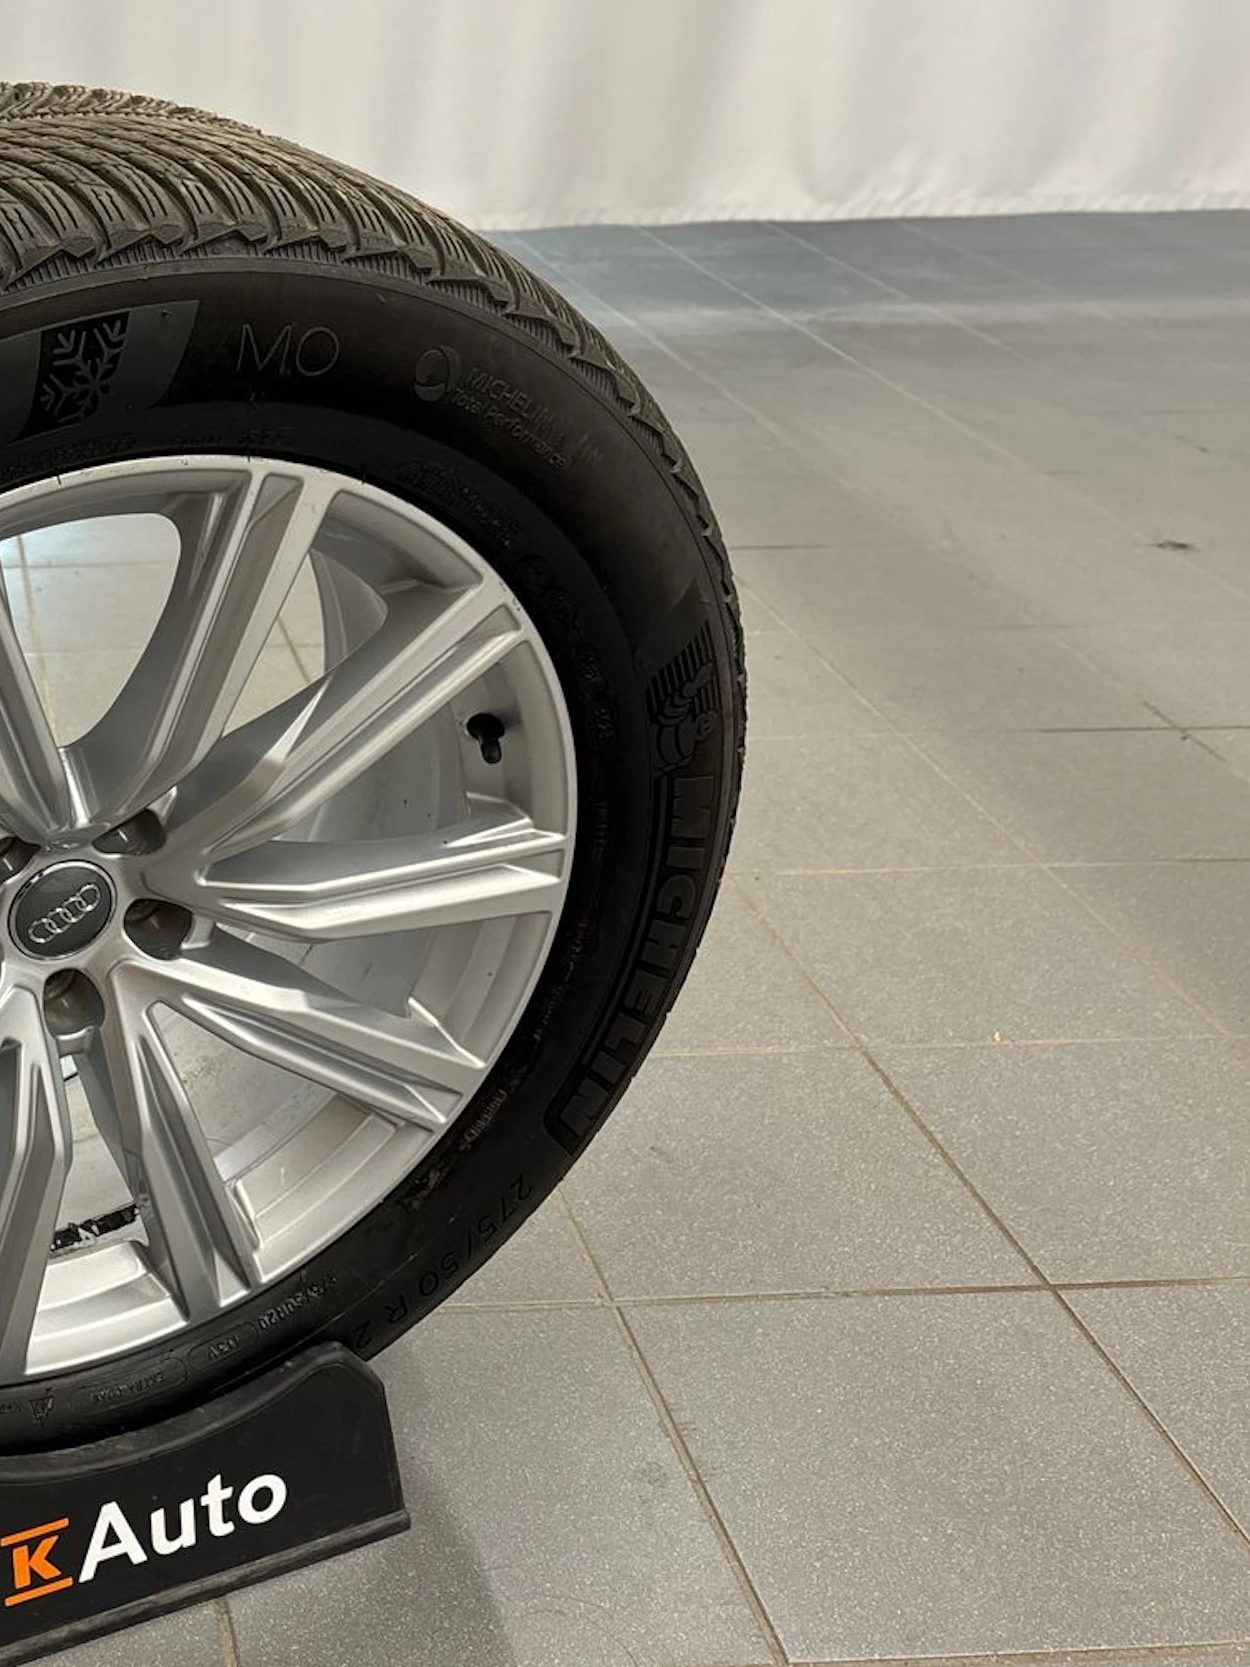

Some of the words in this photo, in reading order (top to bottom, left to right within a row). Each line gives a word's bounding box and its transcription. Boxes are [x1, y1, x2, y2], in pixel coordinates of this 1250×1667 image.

[236, 322, 340, 377] MO
[559, 775, 715, 1140] MICHELIN
[419, 1173, 532, 1296] 275/50
[384, 1295, 407, 1324] R
[77, 1471, 288, 1585] Auto
